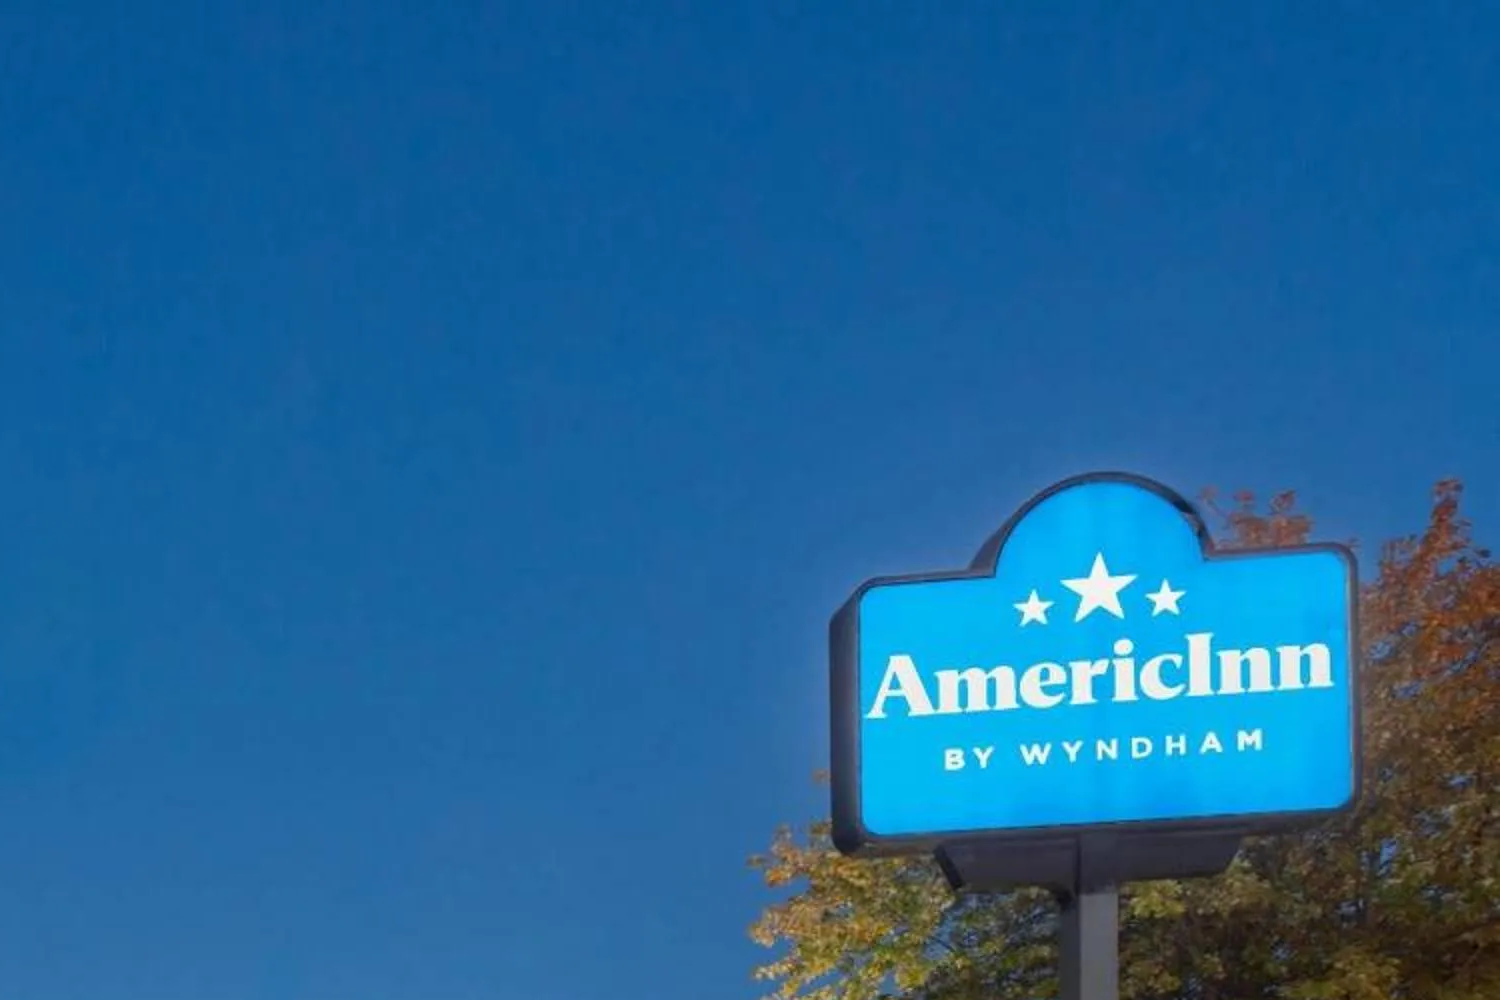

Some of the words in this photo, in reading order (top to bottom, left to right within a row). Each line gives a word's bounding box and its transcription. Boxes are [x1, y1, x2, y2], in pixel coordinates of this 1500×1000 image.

[866, 631, 1334, 719] AmericInn
[943, 746, 994, 771] BY
[1019, 728, 1263, 766] WYNDHAM
